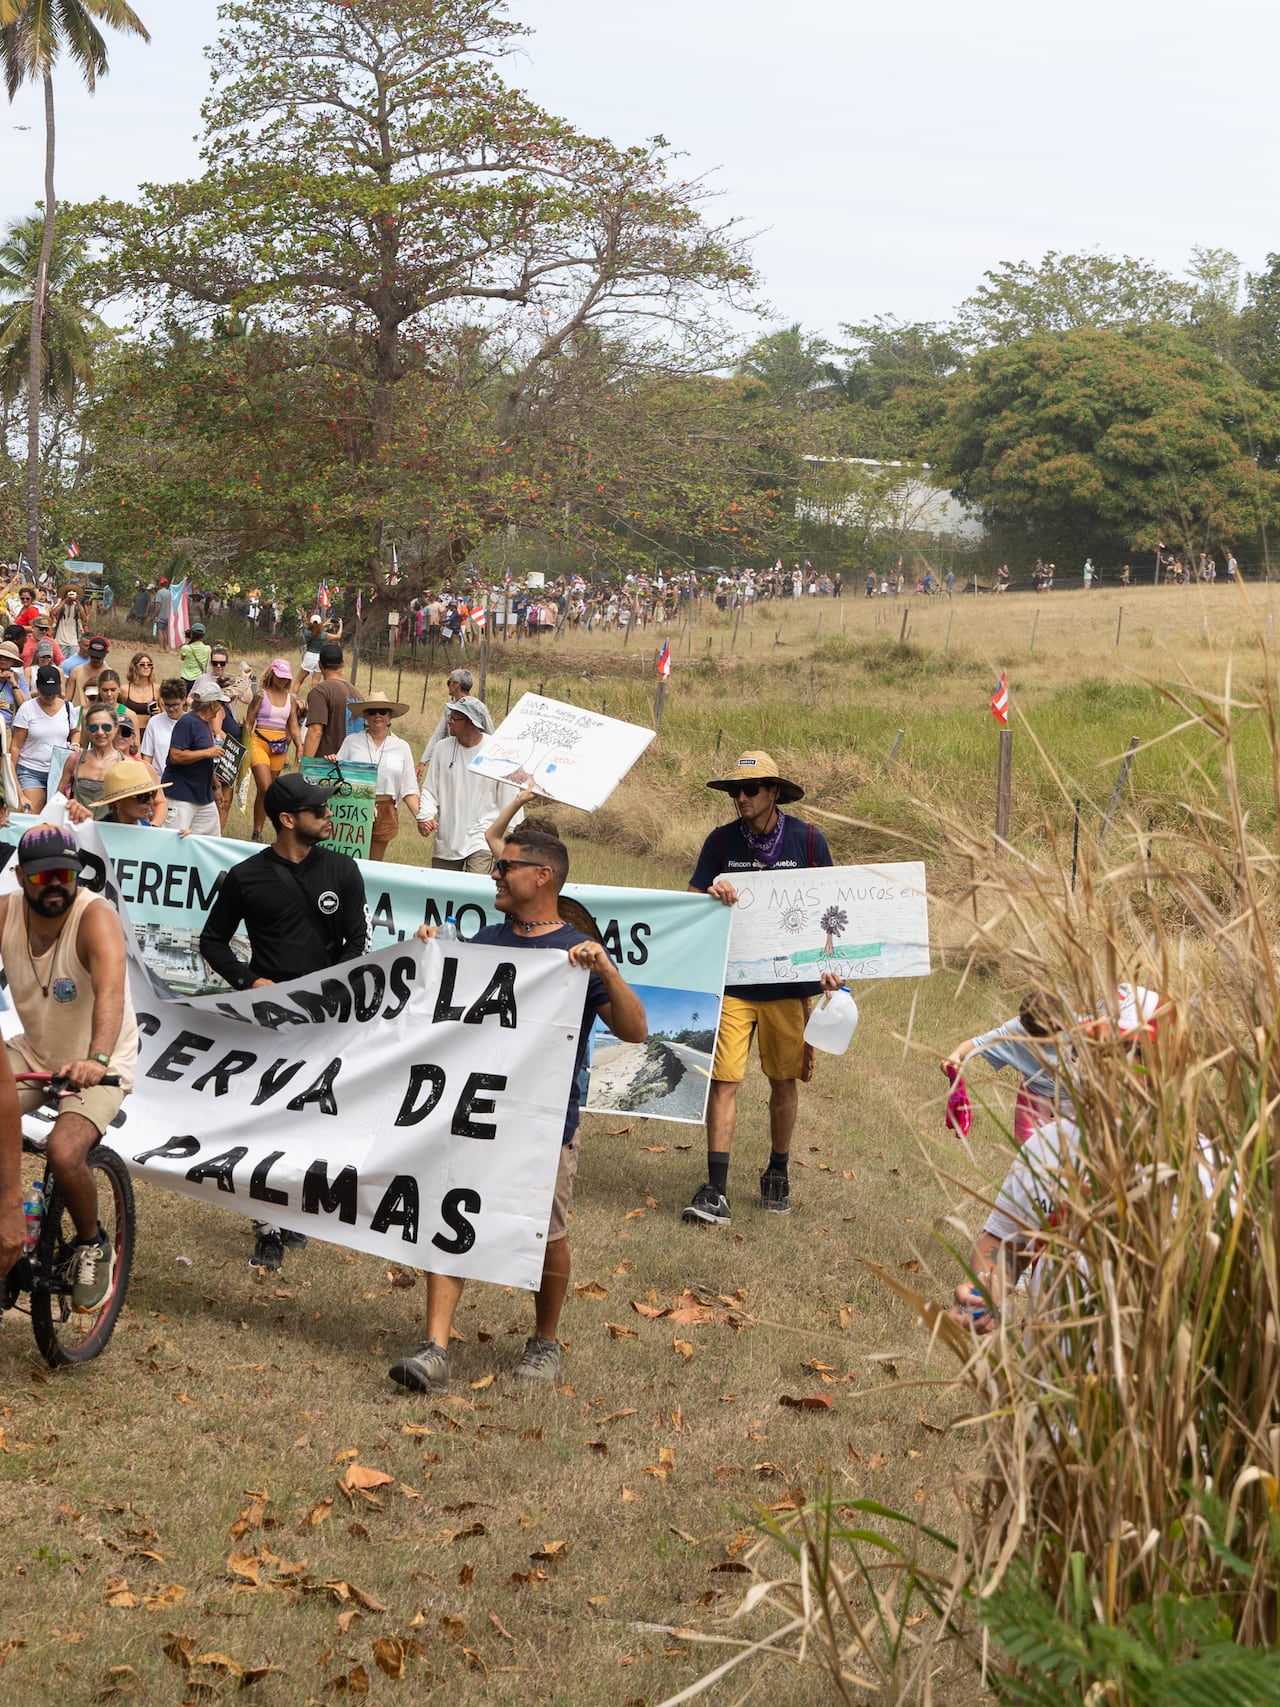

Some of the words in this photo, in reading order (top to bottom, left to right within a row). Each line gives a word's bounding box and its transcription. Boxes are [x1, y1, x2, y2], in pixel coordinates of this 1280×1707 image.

[330, 804, 369, 823] LISTAS
[330, 822, 366, 845] NTRA
[111, 857, 227, 912] EREM
[768, 886, 822, 910] MAS
[216, 956, 417, 1032] AMOS
[431, 956, 518, 1029] LA
[394, 1063, 509, 1140] DE
[133, 1135, 482, 1255] PALMAS
